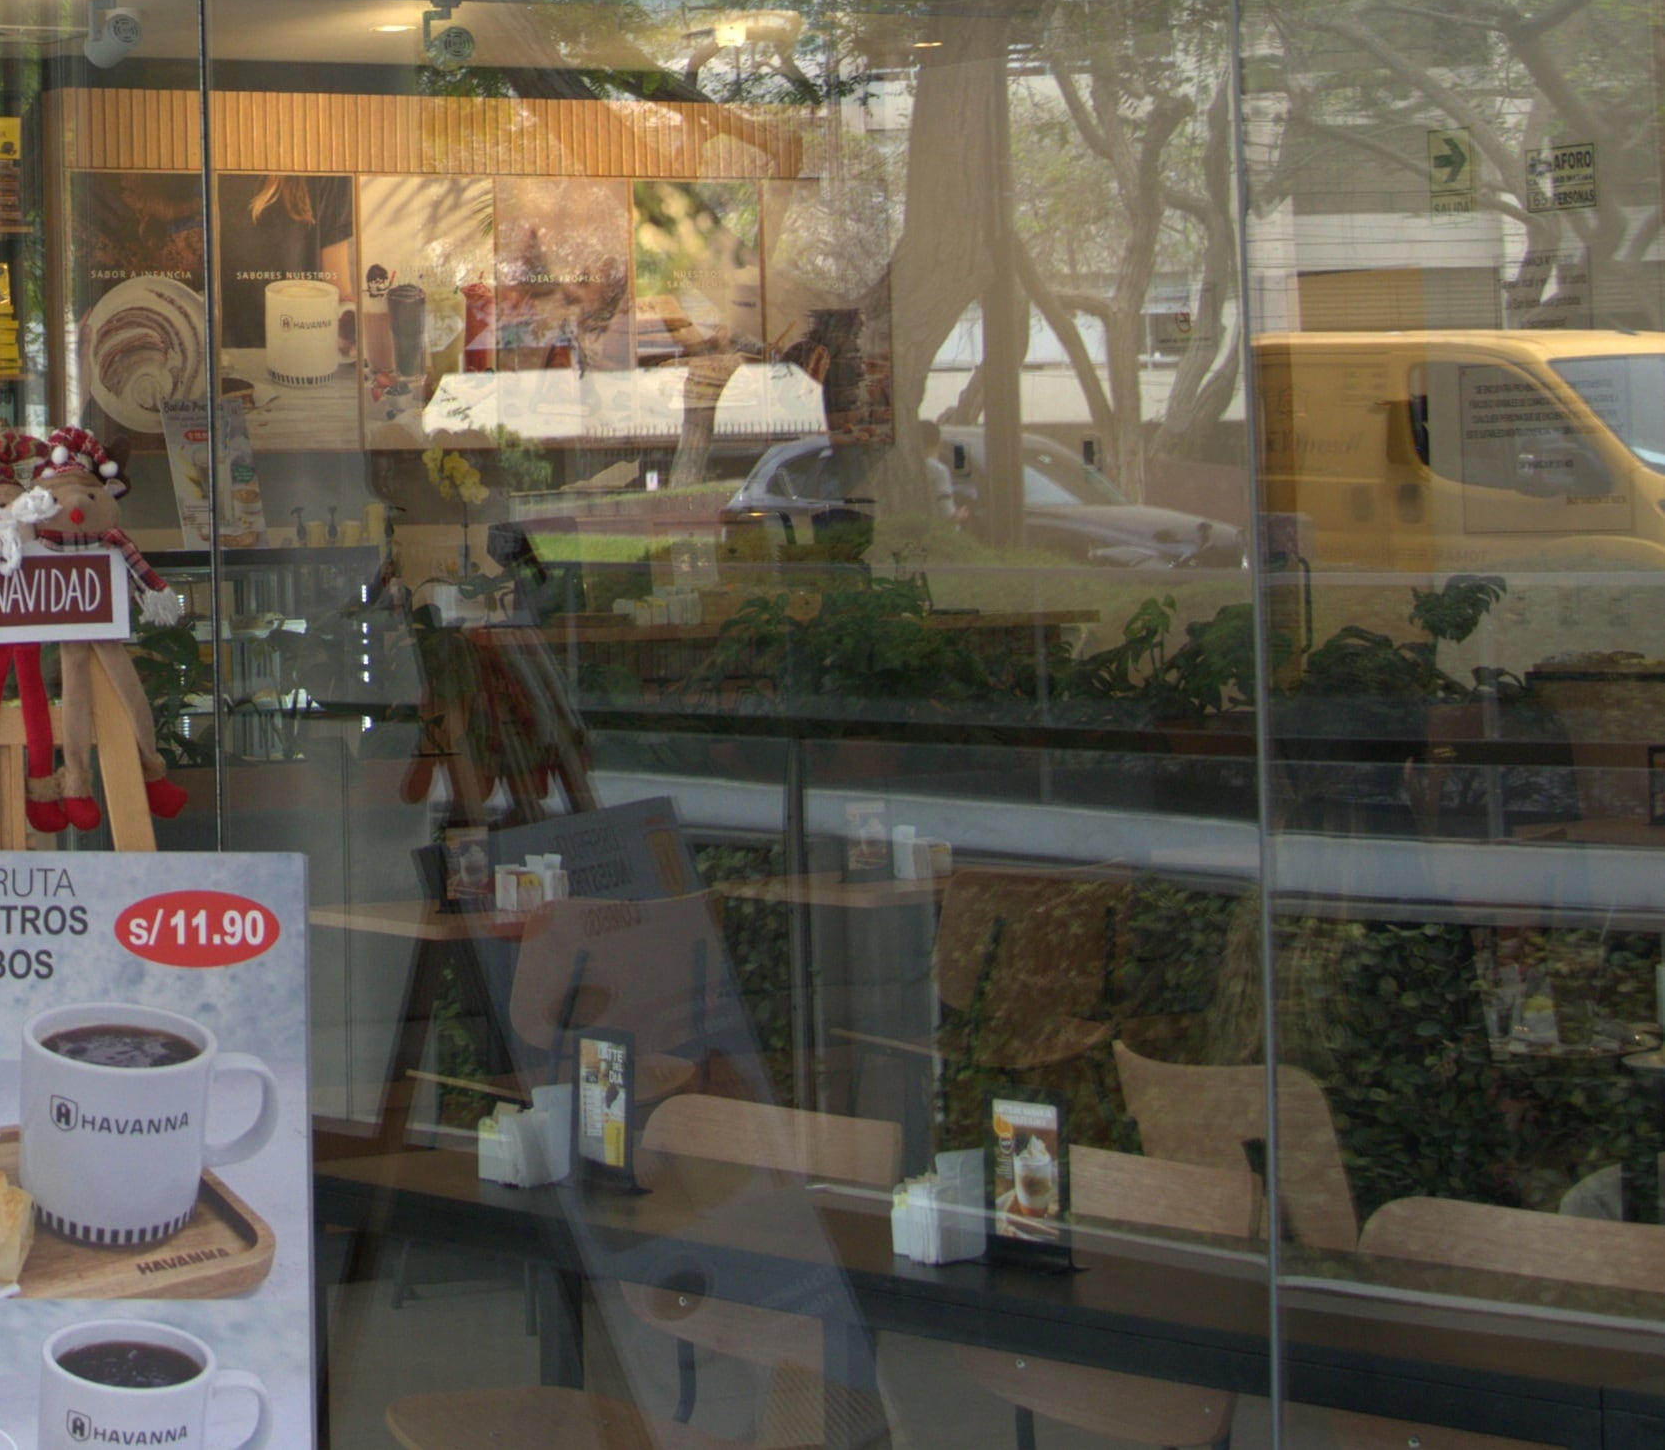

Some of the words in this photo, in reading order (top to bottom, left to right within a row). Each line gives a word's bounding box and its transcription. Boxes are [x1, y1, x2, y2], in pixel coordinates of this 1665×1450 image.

[1553, 150, 1593, 171] AFORO
[1434, 200, 1471, 215] SALIDA
[90, 269, 127, 279] SABOR
[140, 270, 193, 280] INFANCIA
[235, 271, 282, 281] SABORES
[286, 271, 338, 281] NUESTROS
[292, 318, 333, 331] HAVANNA
[170, 910, 265, 945] 11.90
[81, 1112, 189, 1135] HAVANNA
[136, 1248, 231, 1275] HAVANNA
[93, 1425, 188, 1445] HAVANNA
